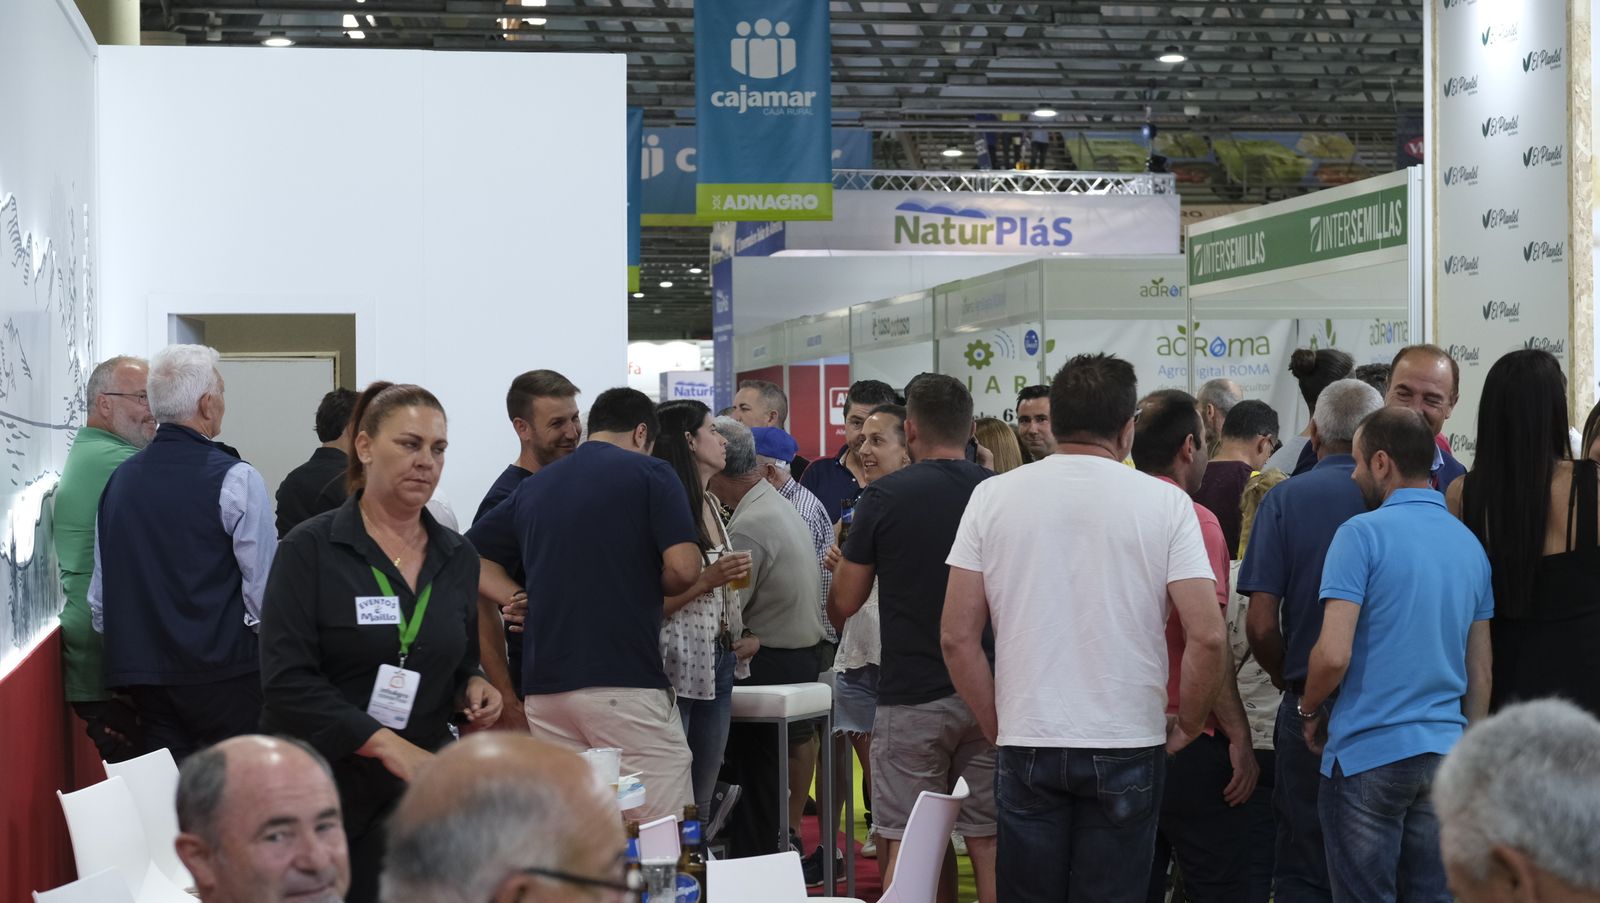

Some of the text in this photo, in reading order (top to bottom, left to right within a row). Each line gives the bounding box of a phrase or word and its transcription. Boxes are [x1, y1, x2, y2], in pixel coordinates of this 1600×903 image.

[1540, 47, 1562, 68] Plantel
[1459, 75, 1478, 93] Plantel
[710, 84, 817, 114] cajamar
[762, 107, 815, 116] CAJA RURAL
[1499, 115, 1519, 132] Plantel
[1541, 145, 1562, 164] Plantel
[1459, 165, 1478, 182] Plantel
[722, 193, 819, 211] ADNAGRO
[1321, 198, 1403, 251] INTERSEMILLAS
[1499, 208, 1519, 226] Plantel
[893, 215, 1074, 247] NaturPláS
[1203, 230, 1266, 276] INTERSEMILLAS
[1541, 241, 1564, 258] Plantel
[1460, 255, 1479, 273] Plantel
[1499, 301, 1520, 318] Plantel
[1460, 344, 1480, 362] Plantel
[1542, 336, 1565, 353] Plantel
[1158, 363, 1271, 379] Agroigital ROMA
